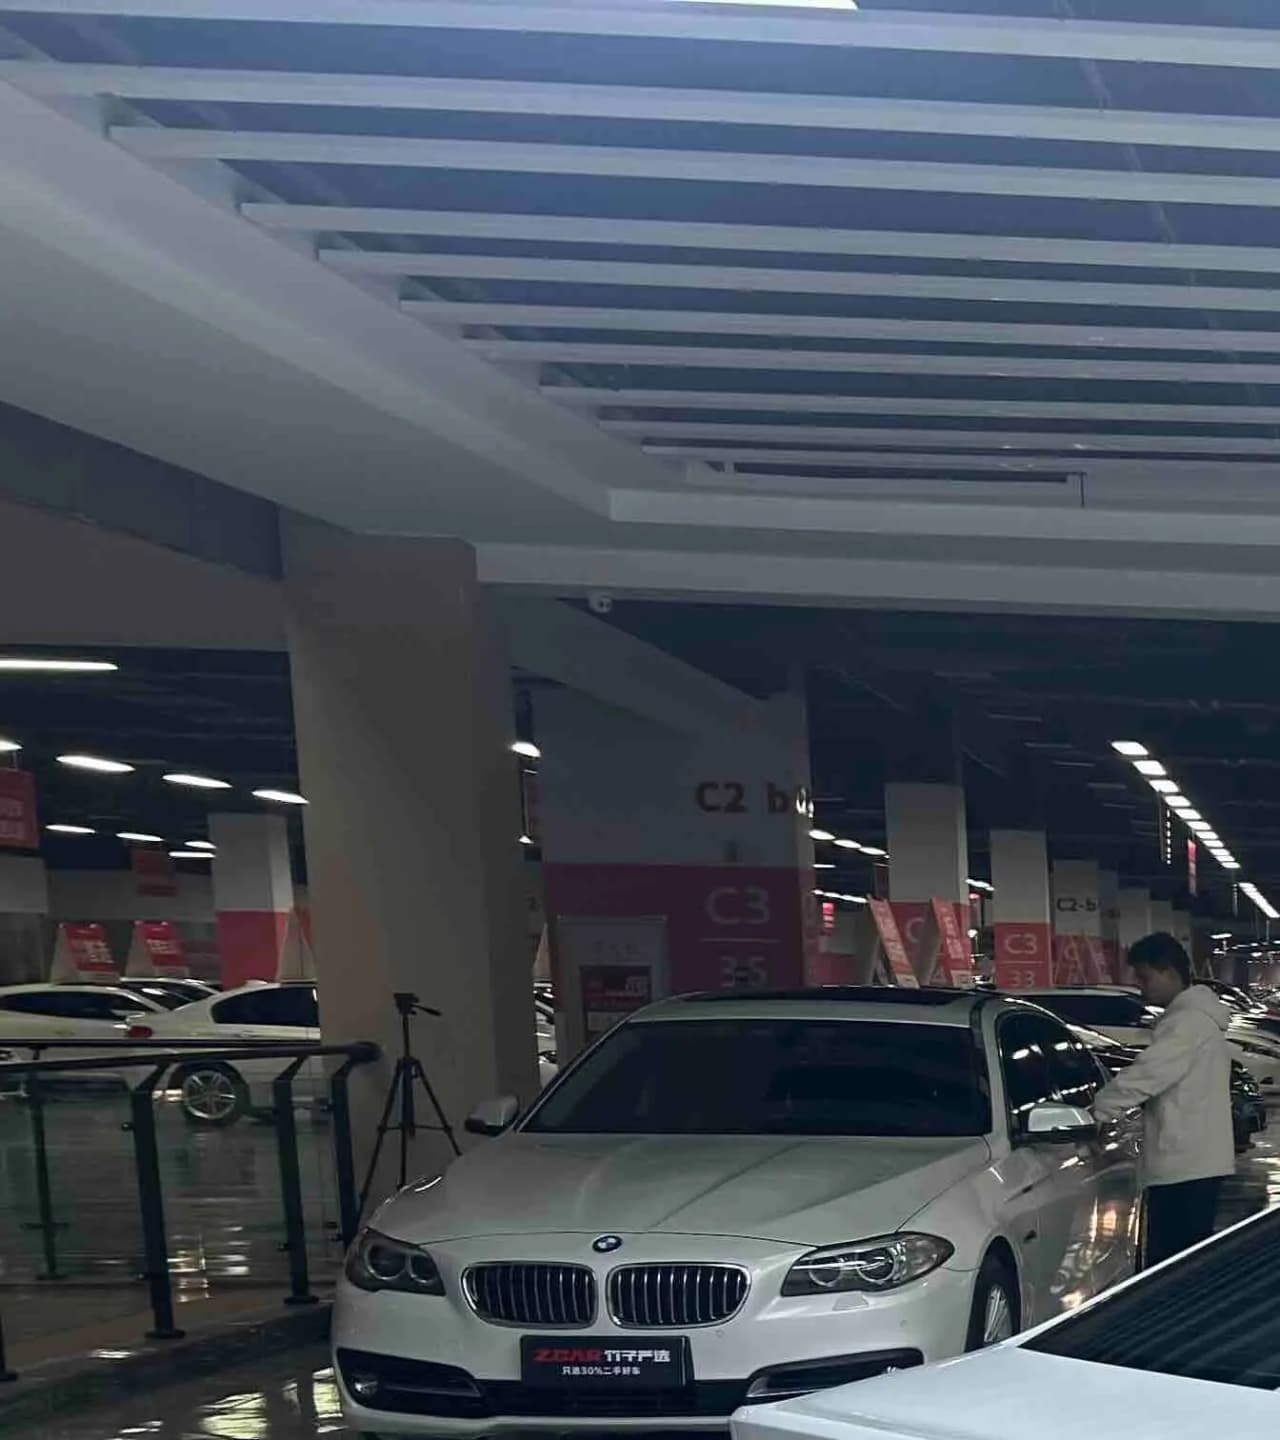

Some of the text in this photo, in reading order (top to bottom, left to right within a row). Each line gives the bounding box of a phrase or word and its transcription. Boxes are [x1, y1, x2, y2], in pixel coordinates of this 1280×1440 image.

[707, 886, 771, 925] C3
[1005, 933, 1038, 955] C3
[534, 1348, 601, 1362] ZCAR
